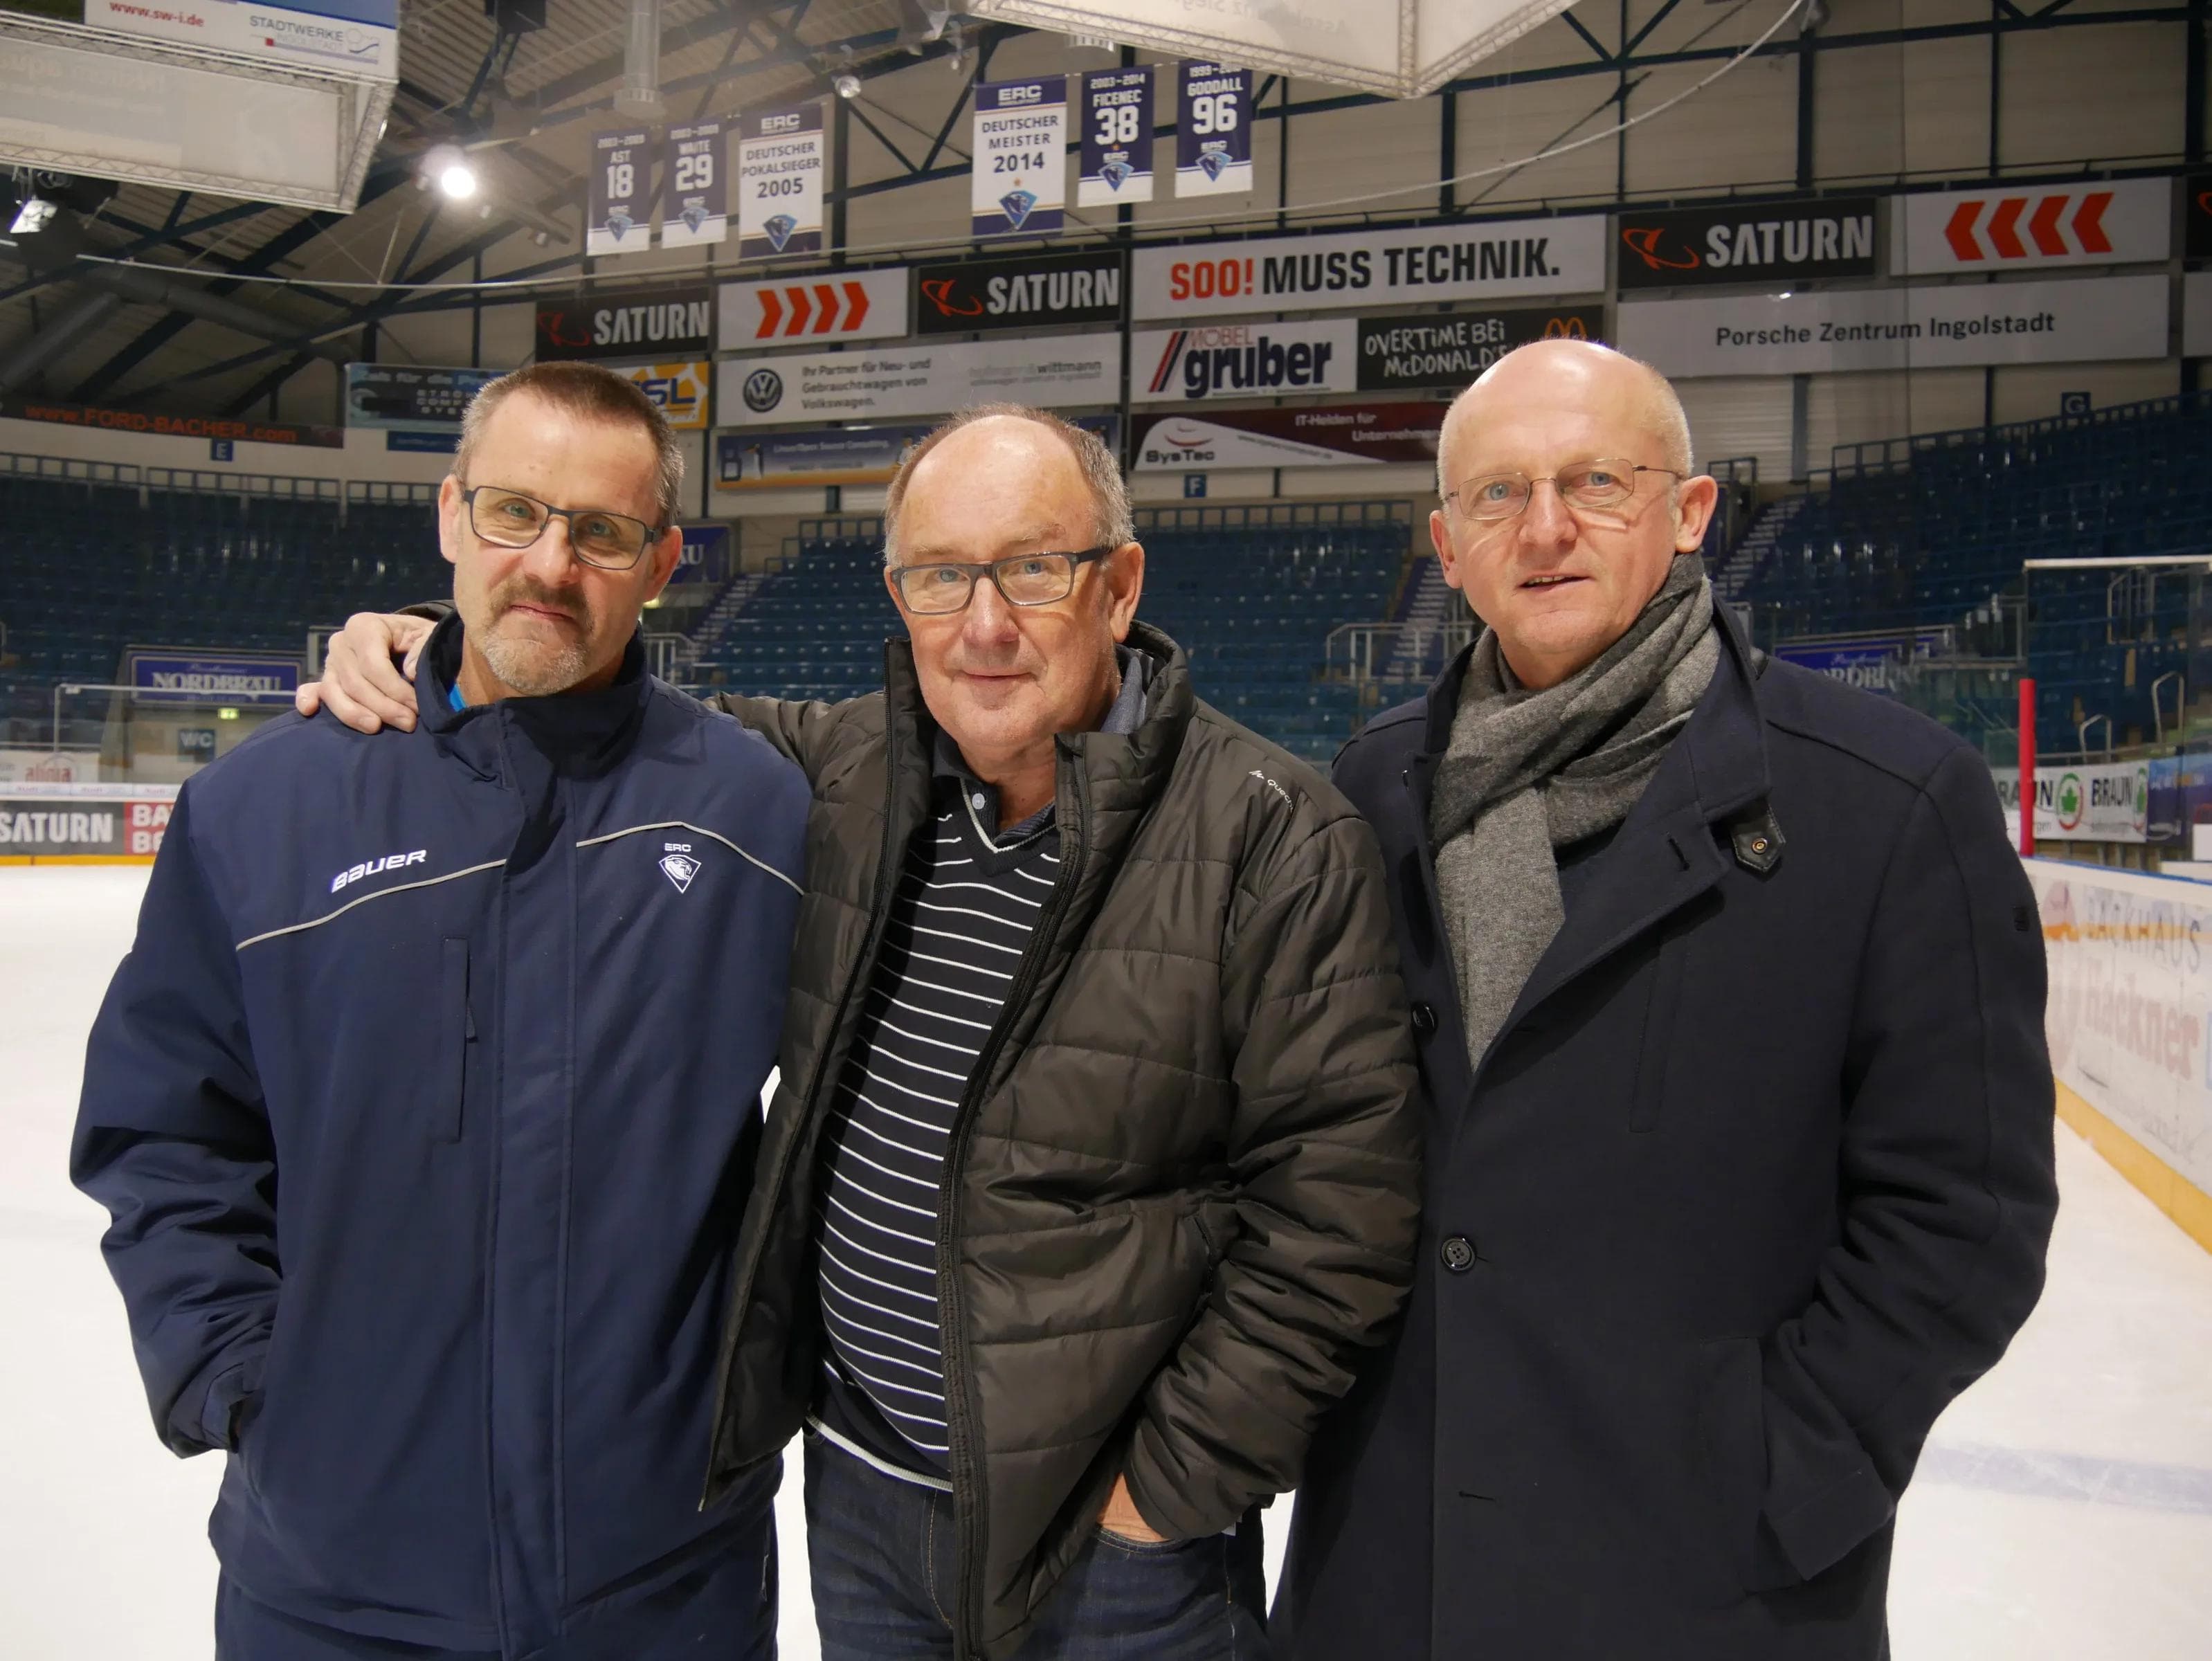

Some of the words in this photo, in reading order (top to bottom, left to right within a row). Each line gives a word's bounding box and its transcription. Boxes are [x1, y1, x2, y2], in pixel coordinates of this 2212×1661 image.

[109, 2, 205, 26] www.sw-i.de
[250, 15, 343, 42] STADTWERKE
[999, 85, 1042, 101] ERC
[1093, 89, 1142, 107] FICENEC
[1188, 78, 1244, 97] GOODALL
[761, 114, 800, 130] ERC
[982, 115, 1058, 133] DEUTSCHER
[1193, 93, 1238, 134] 96
[1095, 105, 1139, 145] 38
[746, 142, 815, 161] DEUTSCHER
[988, 134, 1051, 149] MEISTER
[676, 154, 714, 191] 29
[741, 158, 820, 176] POKALSIEGER
[994, 152, 1044, 173] 2014
[607, 163, 634, 199] 18
[757, 177, 804, 198] 2005
[1707, 215, 1873, 268] SATURN
[1170, 257, 1254, 301] SOO!
[1263, 250, 1371, 296] MUSS
[1384, 238, 1560, 287] TECHNIK.
[987, 268, 1119, 314] SATURN
[593, 300, 709, 345] SATURN
[1716, 324, 1811, 347] Porsche
[1820, 318, 1921, 343] Zentrum
[1930, 312, 2056, 341] Ingolstadt
[909, 358, 932, 370] und
[1184, 336, 1332, 399] gruber
[801, 378, 903, 393] Gebrauchtwagen
[905, 377, 928, 386] von
[2065, 394, 2086, 415] G
[25, 405, 298, 442] www.FORD-BACHER.com
[217, 443, 227, 459] E
[1145, 449, 1215, 464] SysTec
[1189, 478, 1202, 494] F
[180, 732, 212, 749] WC
[2092, 776, 2133, 807] BRAUN
[664, 842, 691, 853] ERC
[331, 850, 427, 893] BAUER
